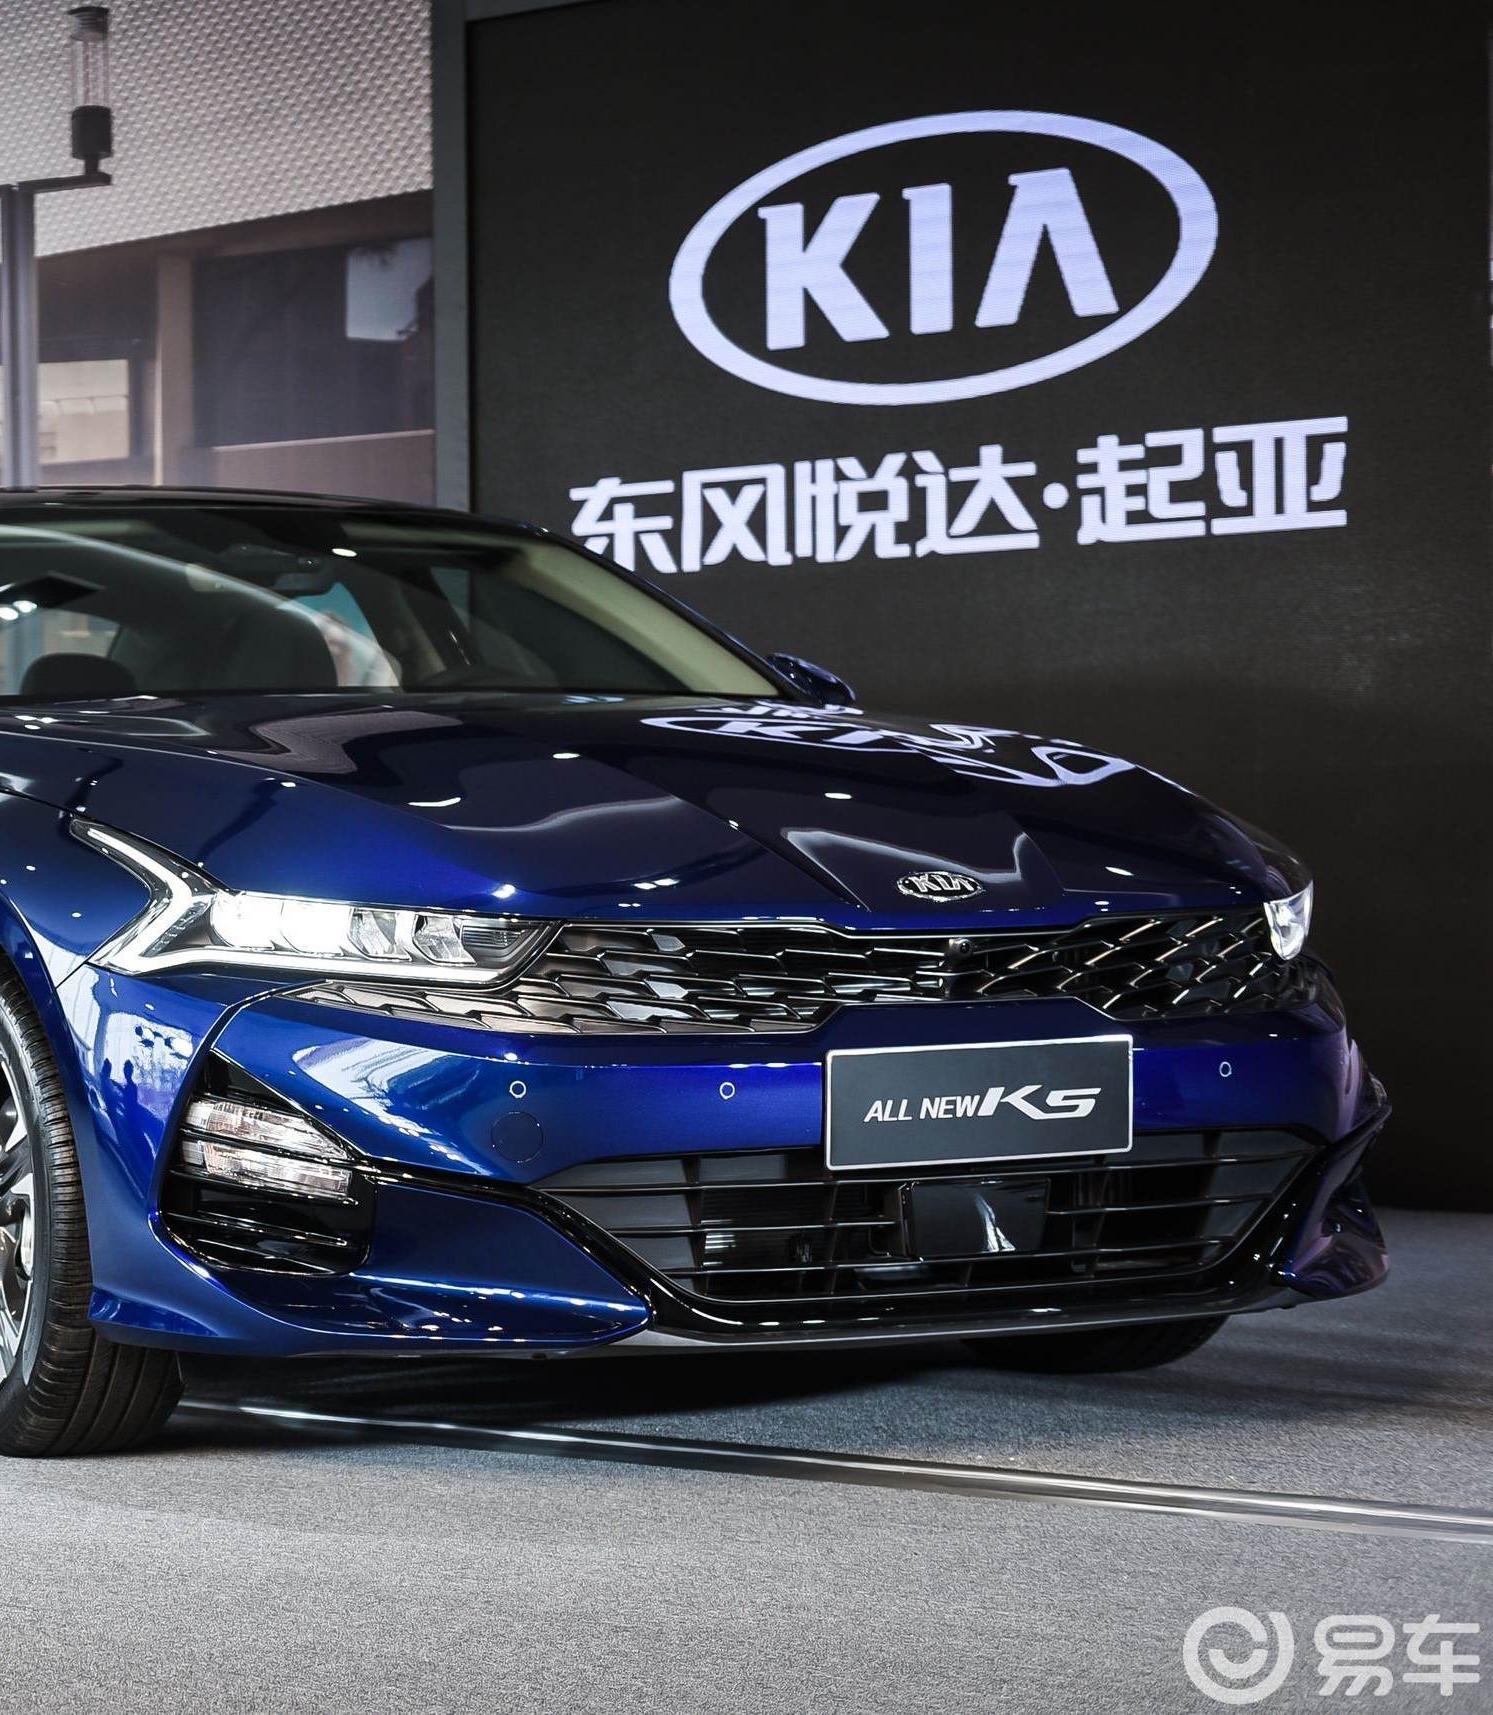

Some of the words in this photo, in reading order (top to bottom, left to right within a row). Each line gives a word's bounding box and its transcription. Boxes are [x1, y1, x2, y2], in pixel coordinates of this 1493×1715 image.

[758, 168, 1119, 351] KIA
[863, 1100, 912, 1122] ALL
[920, 1095, 980, 1119] NEW
